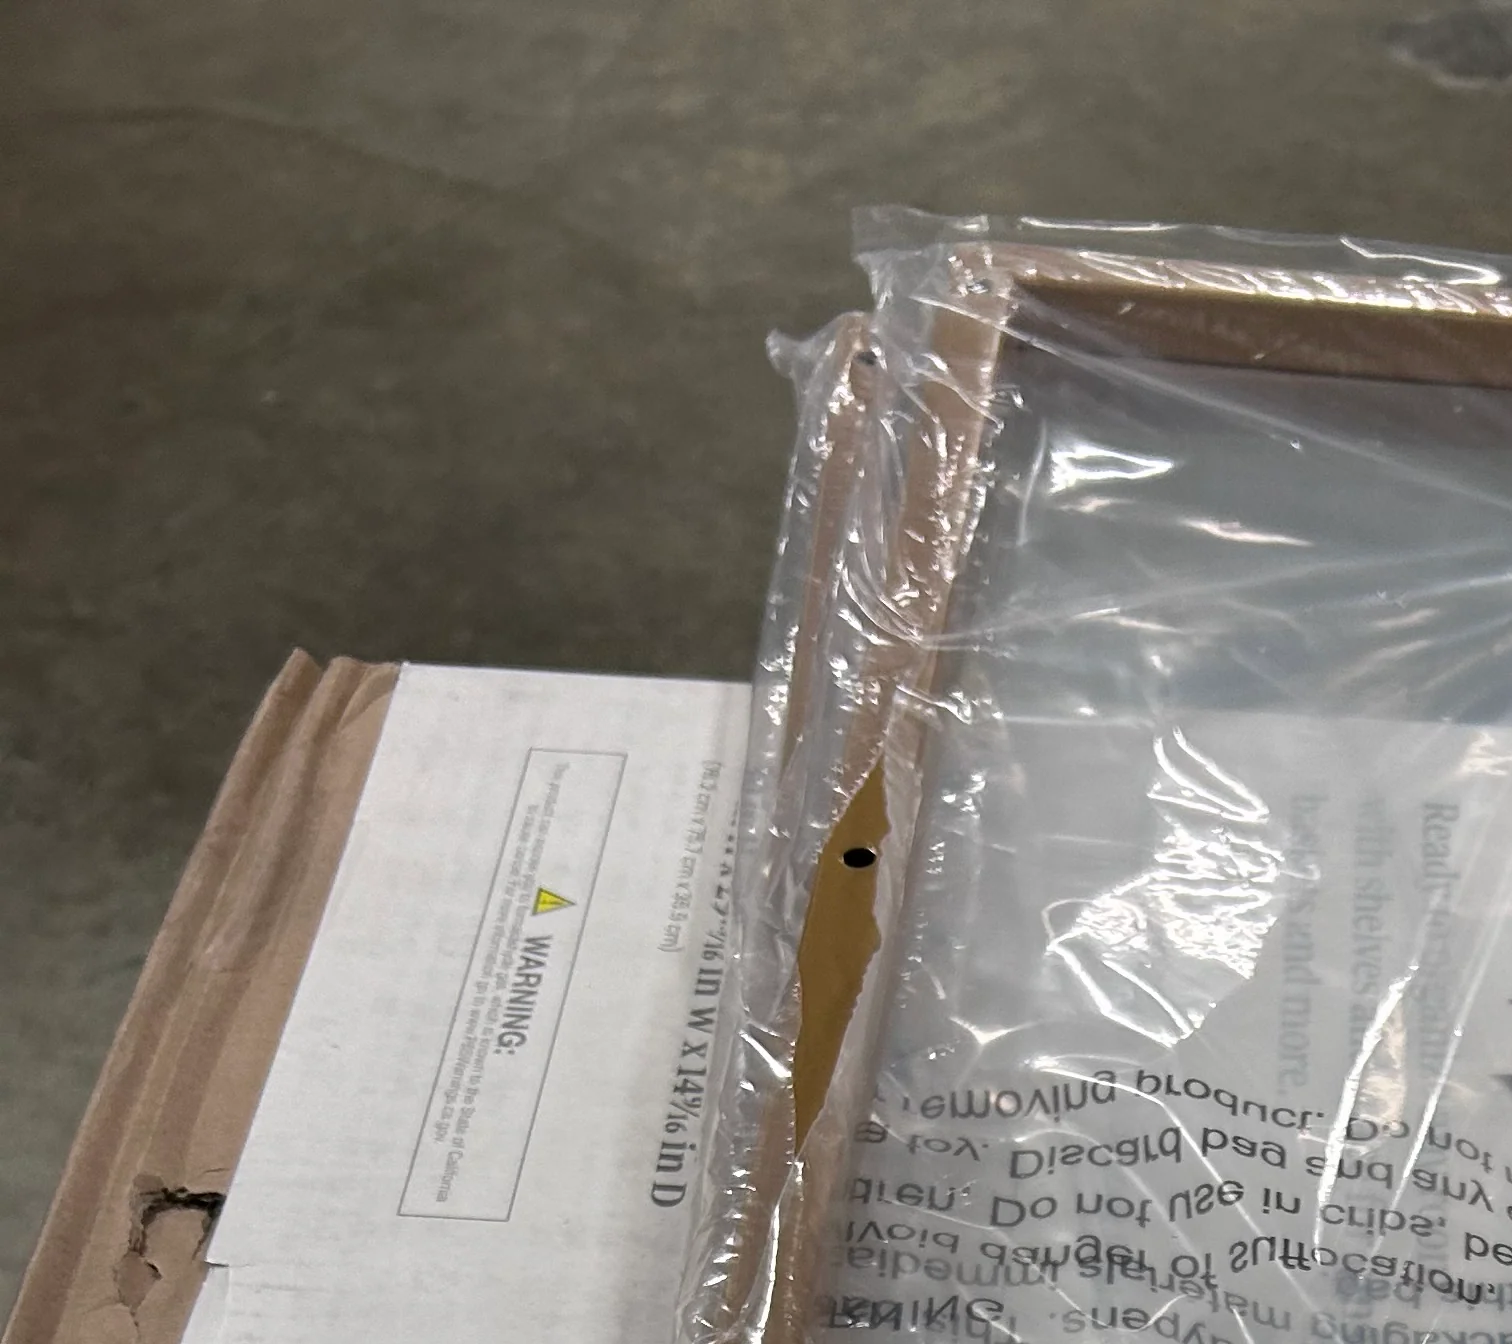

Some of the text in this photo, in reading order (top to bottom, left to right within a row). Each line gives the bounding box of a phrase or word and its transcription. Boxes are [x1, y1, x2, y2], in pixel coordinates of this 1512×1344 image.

[1352, 878, 1392, 996] shelves
[495, 934, 554, 1056] WARNING:
[686, 1007, 716, 1033] W
[657, 1142, 695, 1173] in
[650, 1181, 688, 1209] D
